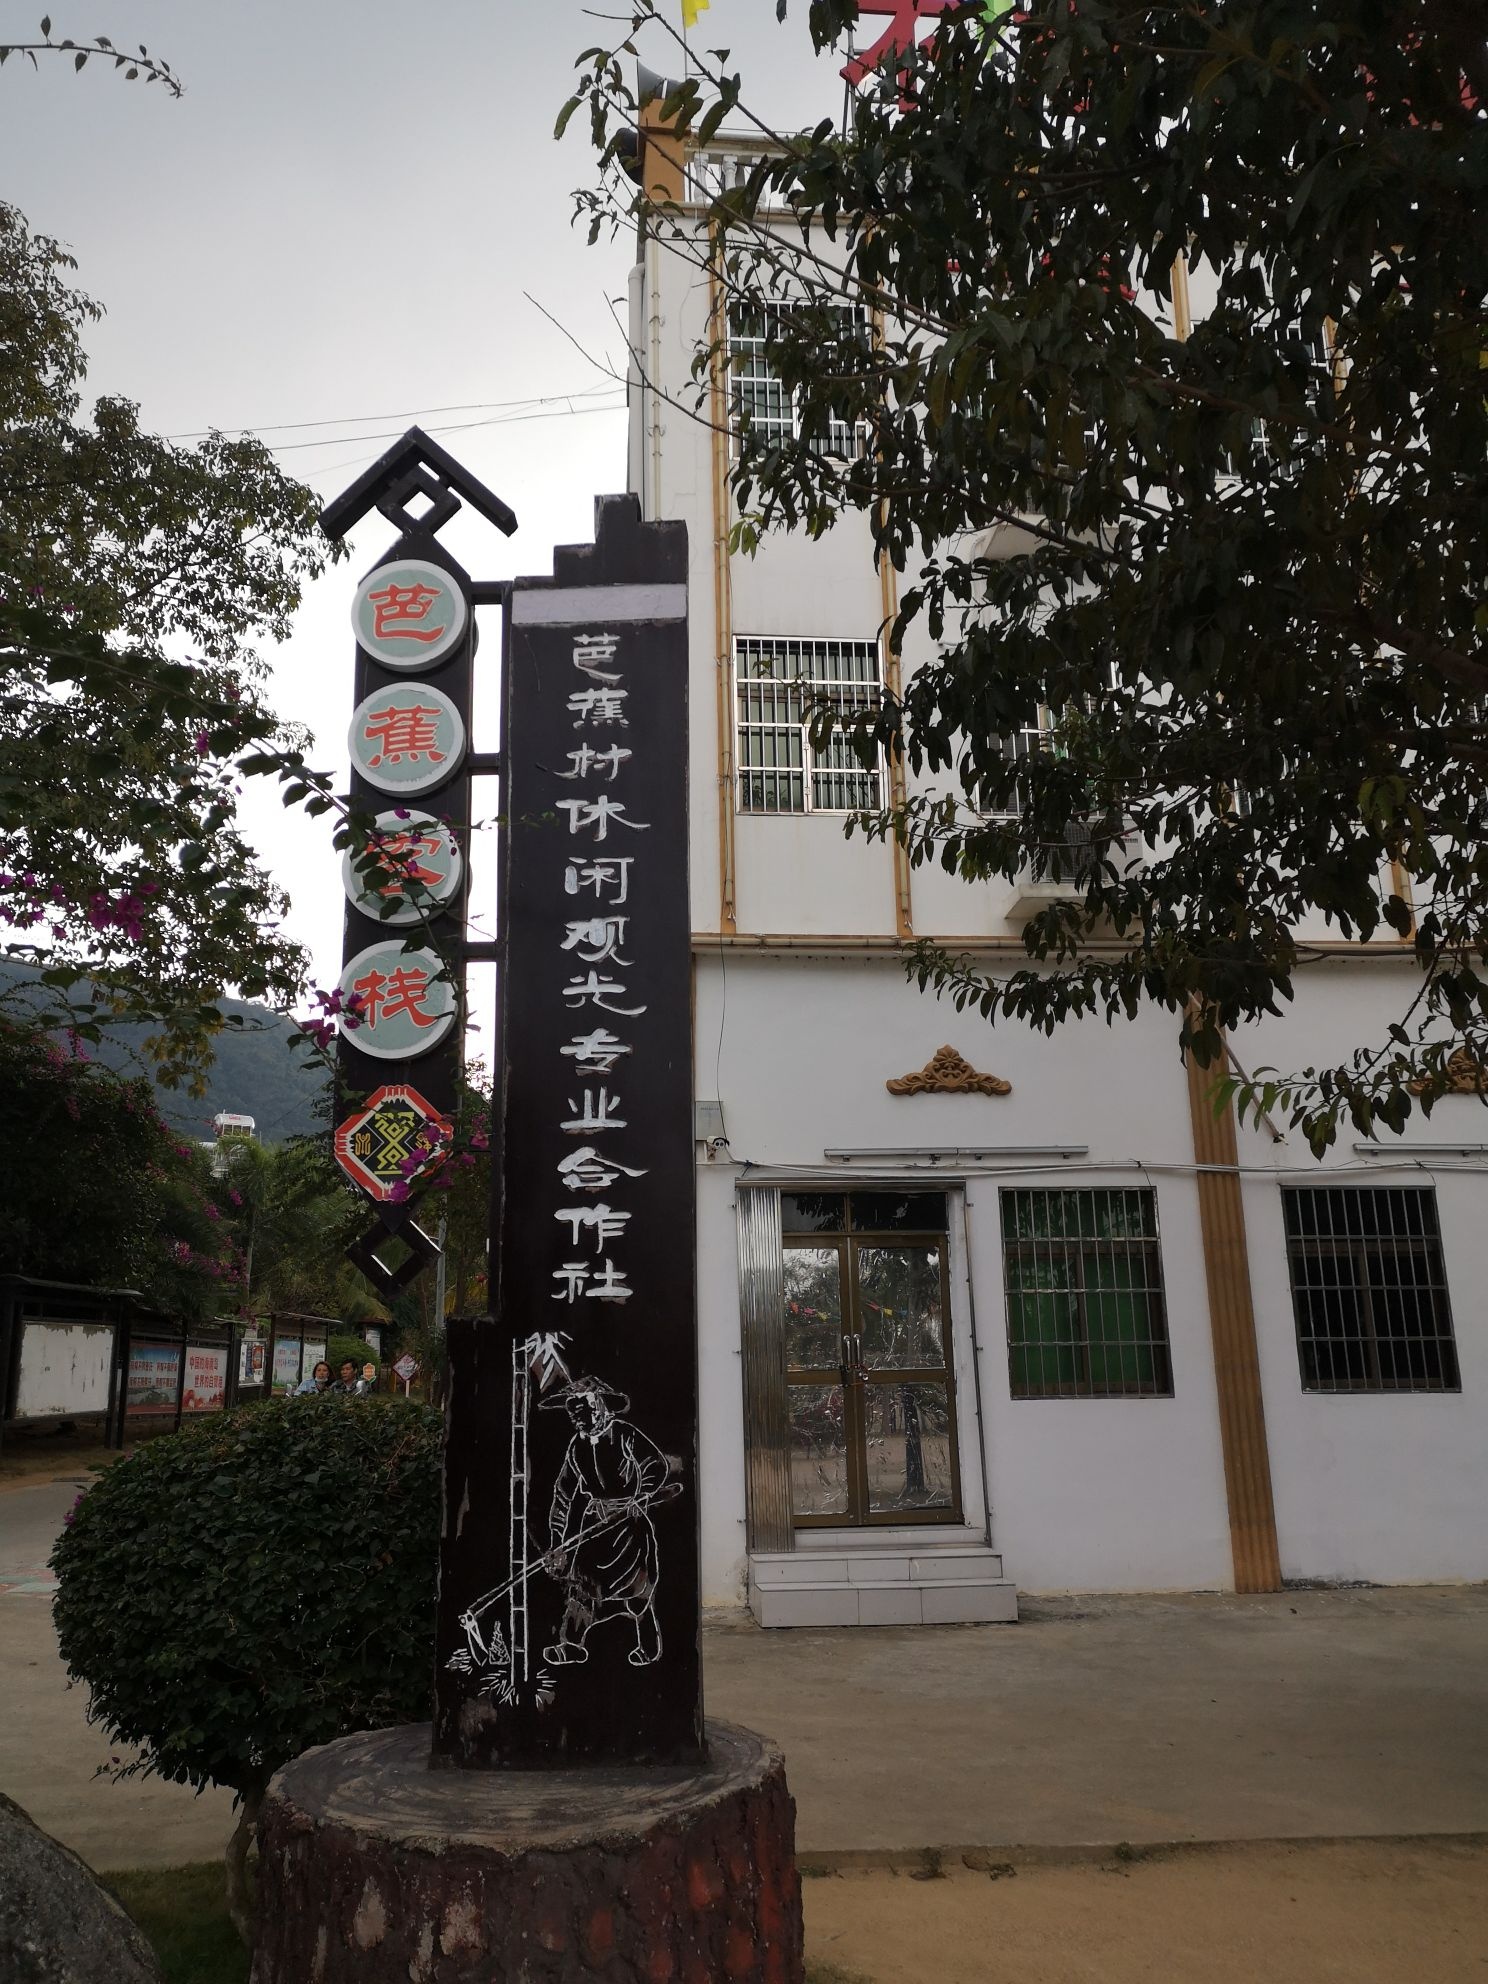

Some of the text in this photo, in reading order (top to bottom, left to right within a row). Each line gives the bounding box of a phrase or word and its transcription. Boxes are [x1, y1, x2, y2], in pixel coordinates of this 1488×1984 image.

[552, 632, 651, 1304] 芭蕉村休闲观光专业合作社
